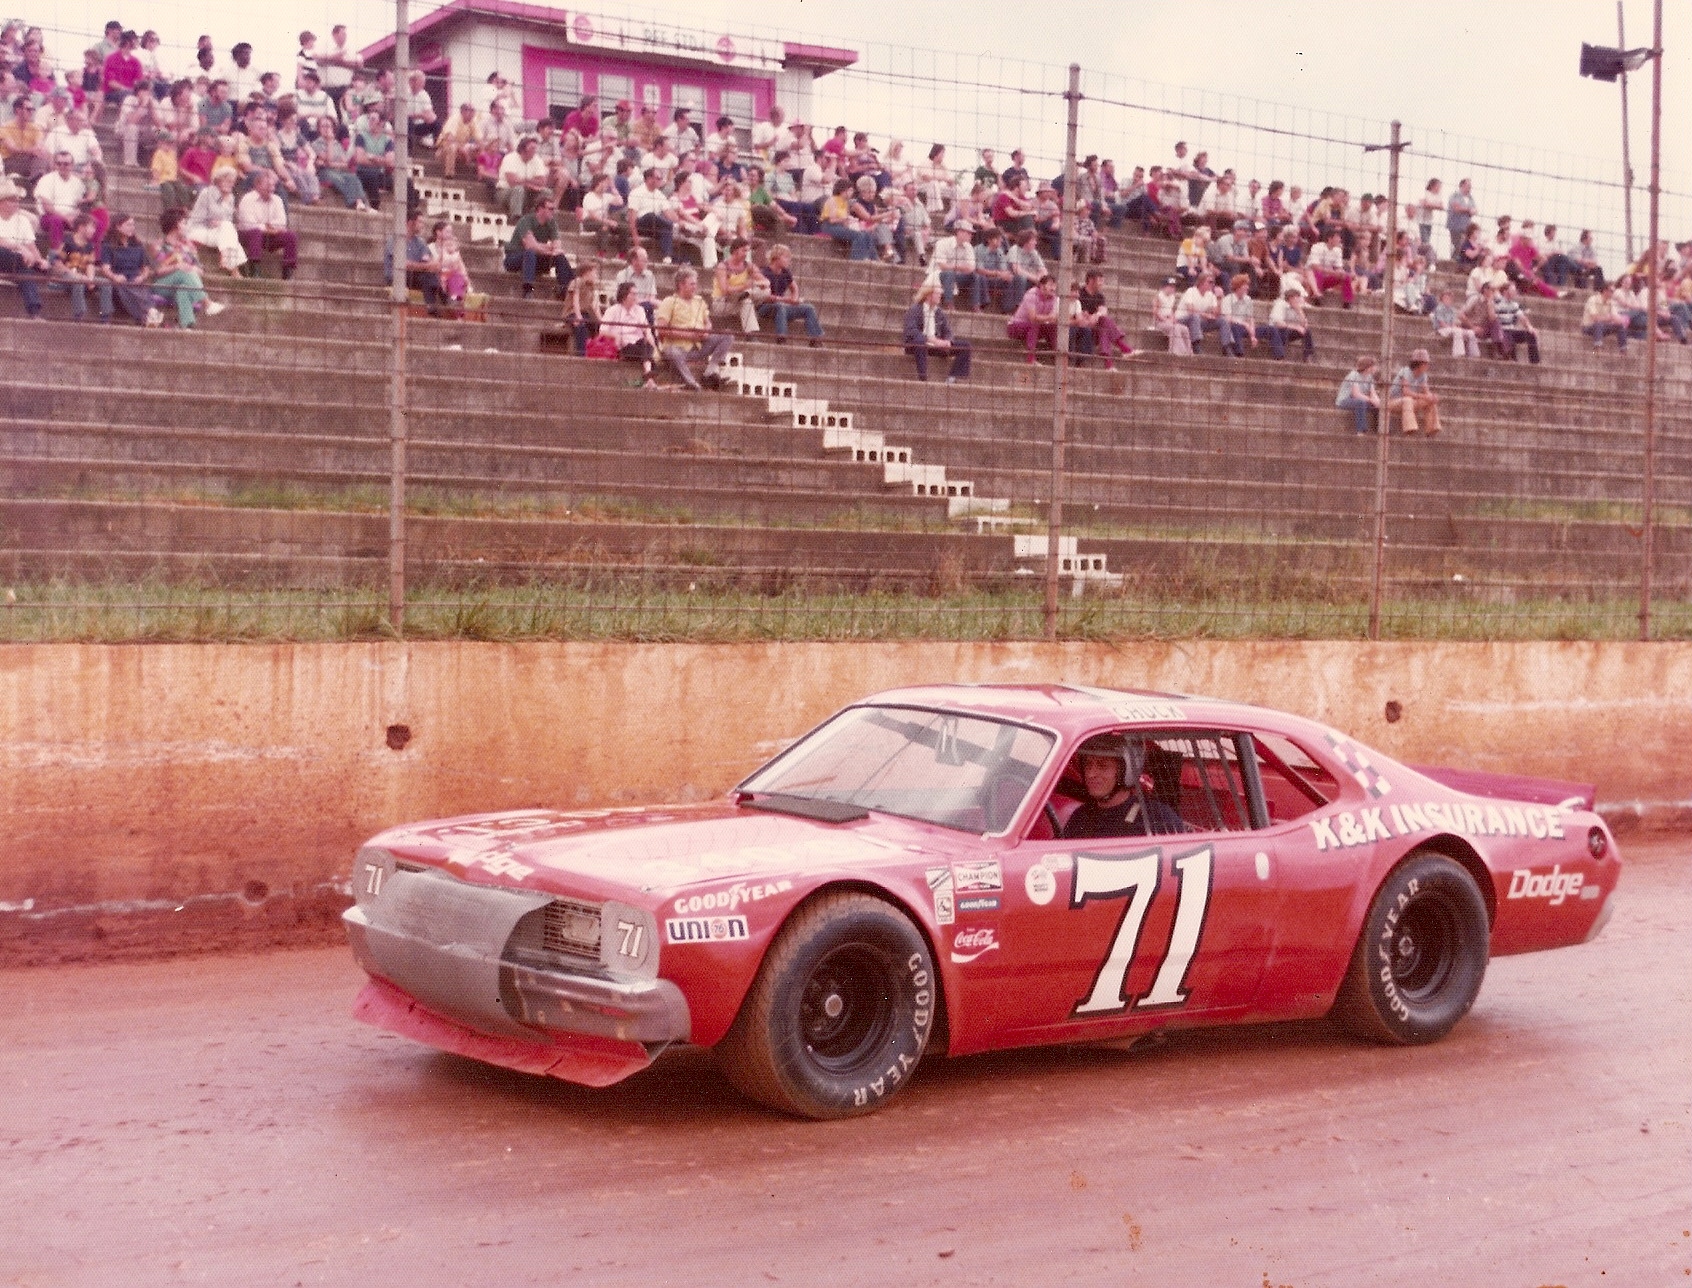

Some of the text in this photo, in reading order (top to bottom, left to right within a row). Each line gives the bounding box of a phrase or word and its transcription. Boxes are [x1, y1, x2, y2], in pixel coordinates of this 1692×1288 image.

[1309, 803, 1566, 851] K&K INSURANCE
[364, 863, 384, 895] 71
[958, 871, 998, 882] CHAMPION
[1507, 865, 1585, 905] Dodge
[673, 881, 794, 914] GOODYEAR
[616, 921, 644, 957] 71
[1068, 843, 1215, 1020] 71
